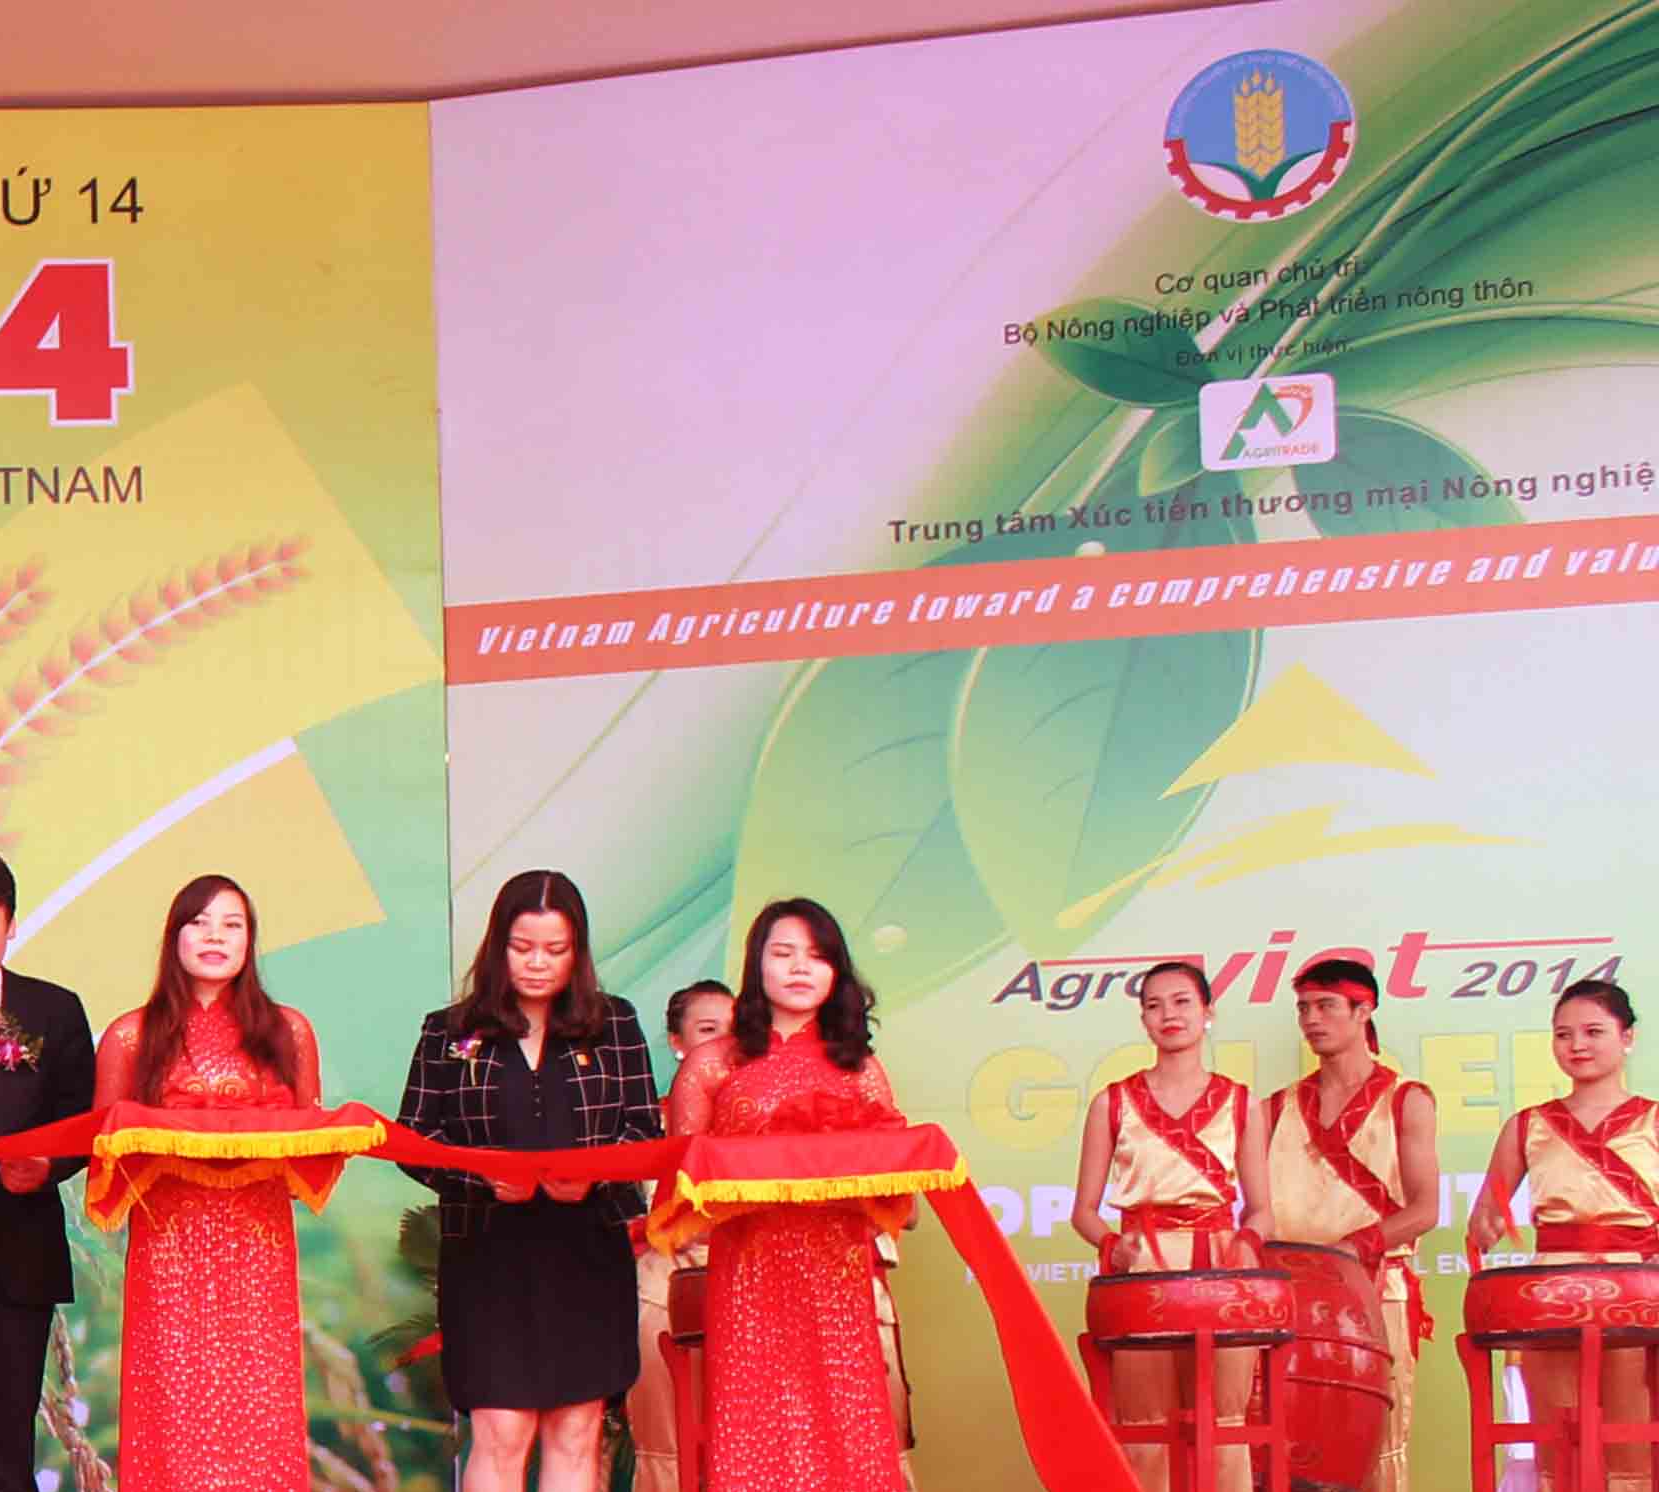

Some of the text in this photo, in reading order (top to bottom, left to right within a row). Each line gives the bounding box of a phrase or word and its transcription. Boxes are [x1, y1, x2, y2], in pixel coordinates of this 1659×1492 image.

[77, 176, 144, 225] 14
[1004, 323, 1037, 346] Bộ
[1047, 318, 1115, 340] Nông
[1124, 308, 1210, 336] nghiệp
[1220, 302, 1249, 323] và
[1397, 286, 1464, 309] nông
[1473, 277, 1533, 301] thôn
[1155, 272, 1194, 294] Cơ
[1203, 268, 1268, 293] quan
[889, 519, 984, 545] Trung
[996, 510, 1056, 536] tâm
[1067, 502, 1132, 531] Xúc
[1221, 488, 1354, 518] thương
[1367, 479, 1429, 510] mại
[1443, 475, 1538, 501] Nông
[477, 618, 636, 656] Vietnam
[647, 596, 897, 646] Agriculture
[908, 583, 1062, 624] toward
[1070, 584, 1097, 612] a
[1108, 559, 1452, 610] comprehensive
[1466, 546, 1553, 584] and
